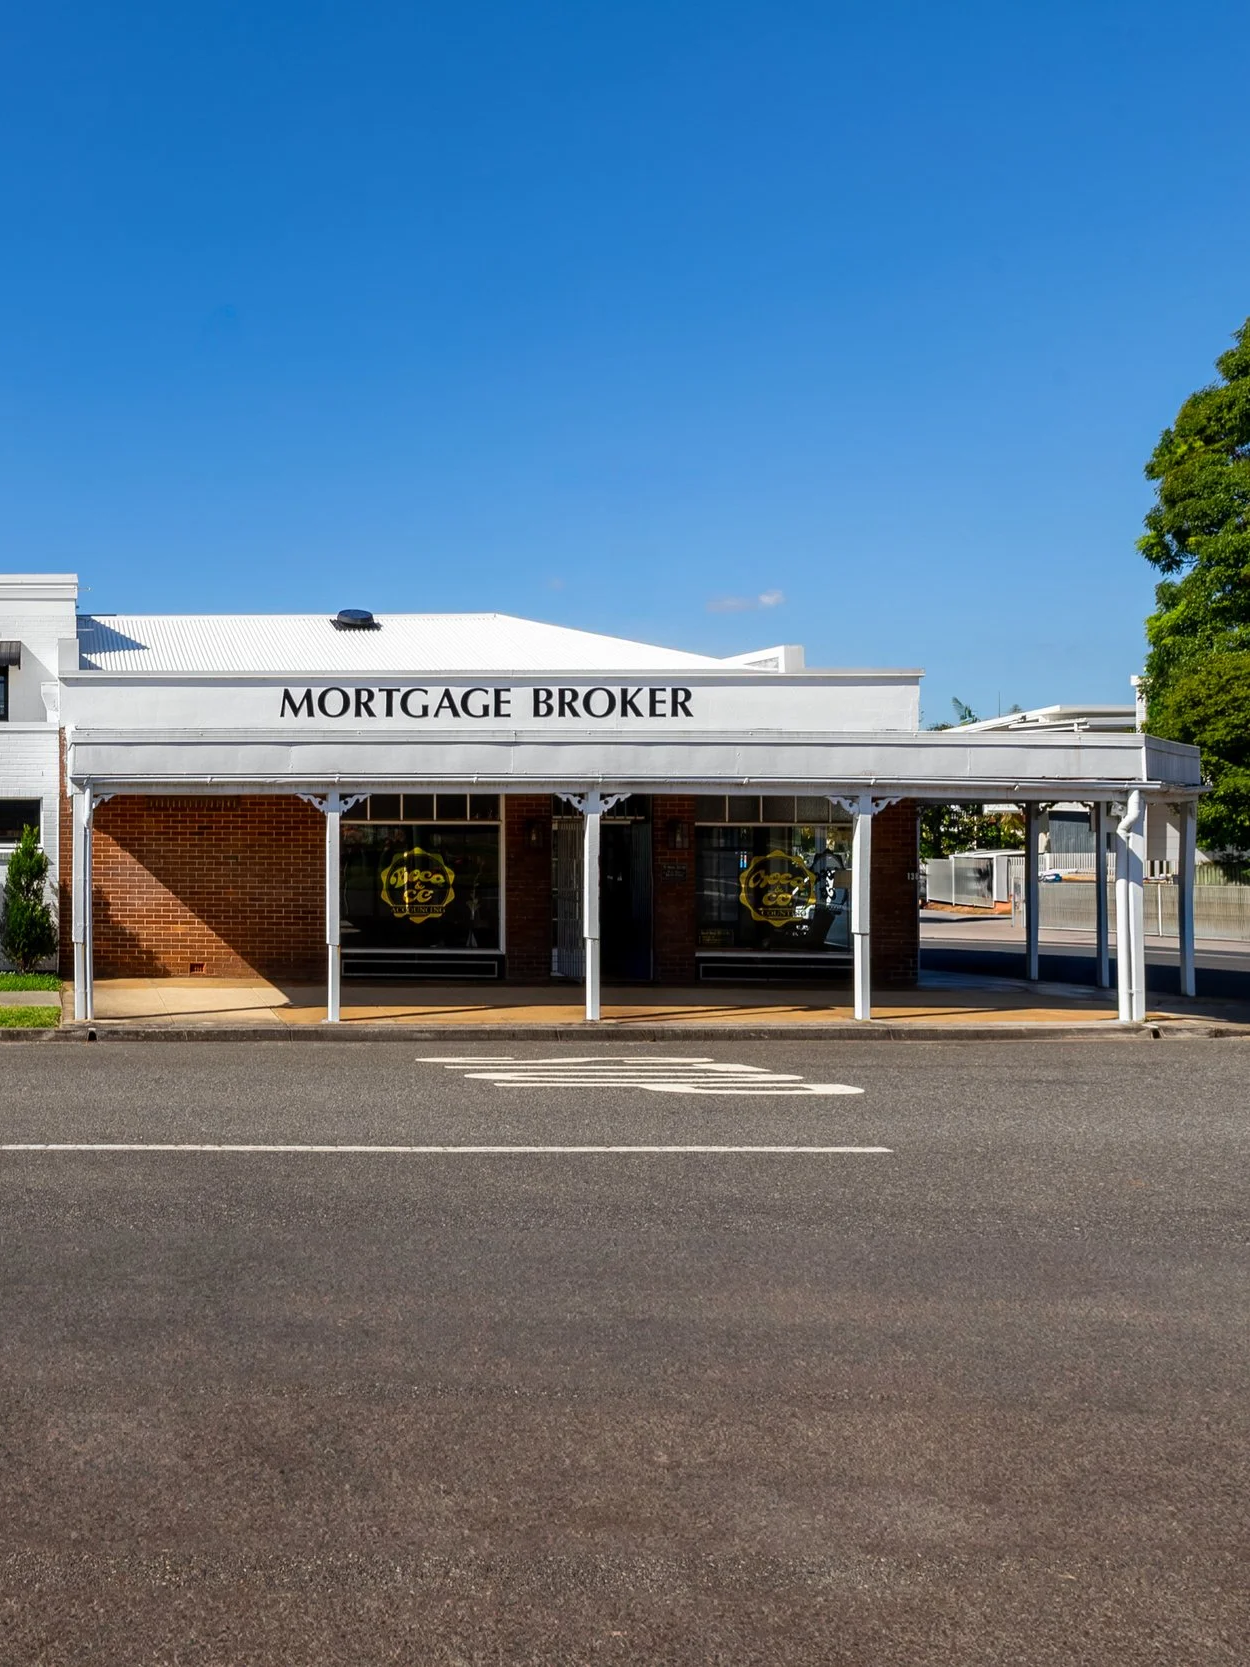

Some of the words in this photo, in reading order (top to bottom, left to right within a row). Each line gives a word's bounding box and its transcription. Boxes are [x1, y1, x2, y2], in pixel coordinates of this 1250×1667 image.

[279, 686, 511, 719] MORTGAGE
[532, 686, 694, 719] BROKER
[414, 881, 425, 890] &
[415, 1057, 866, 1096] STOP
